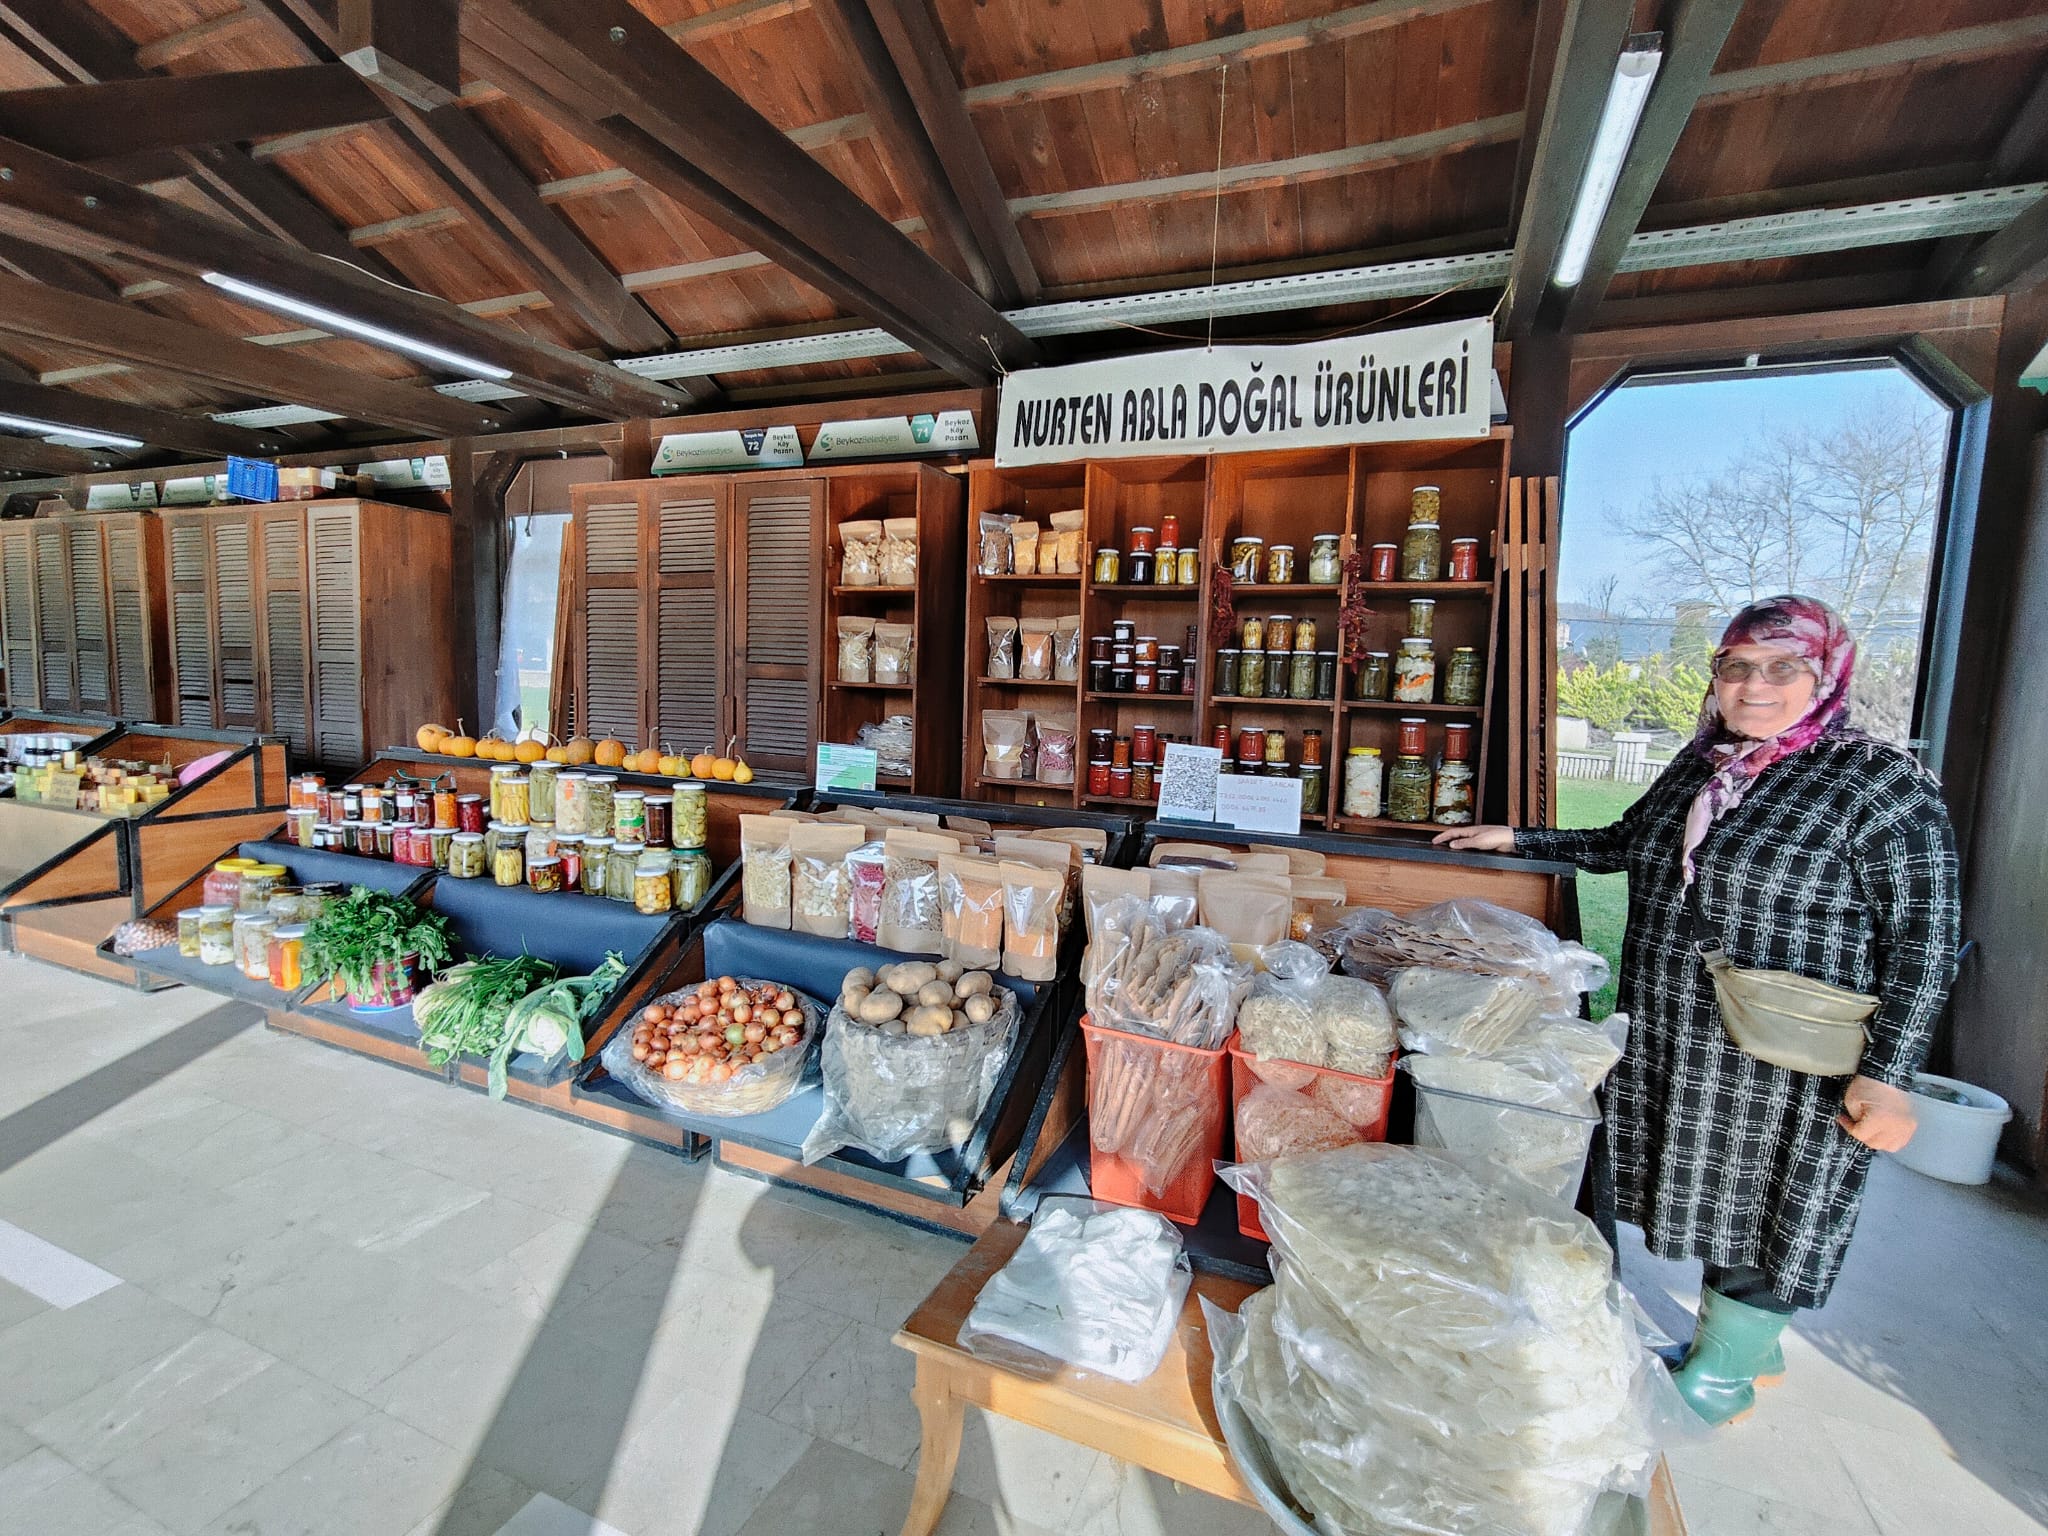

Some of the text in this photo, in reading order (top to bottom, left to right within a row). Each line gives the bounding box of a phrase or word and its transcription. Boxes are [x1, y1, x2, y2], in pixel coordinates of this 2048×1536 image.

[1014, 338, 1469, 448] NURTEN ABLA DOĞAL ÜRÜNLERİ
[944, 418, 969, 427] Beykoz
[747, 442, 760, 451] 72
